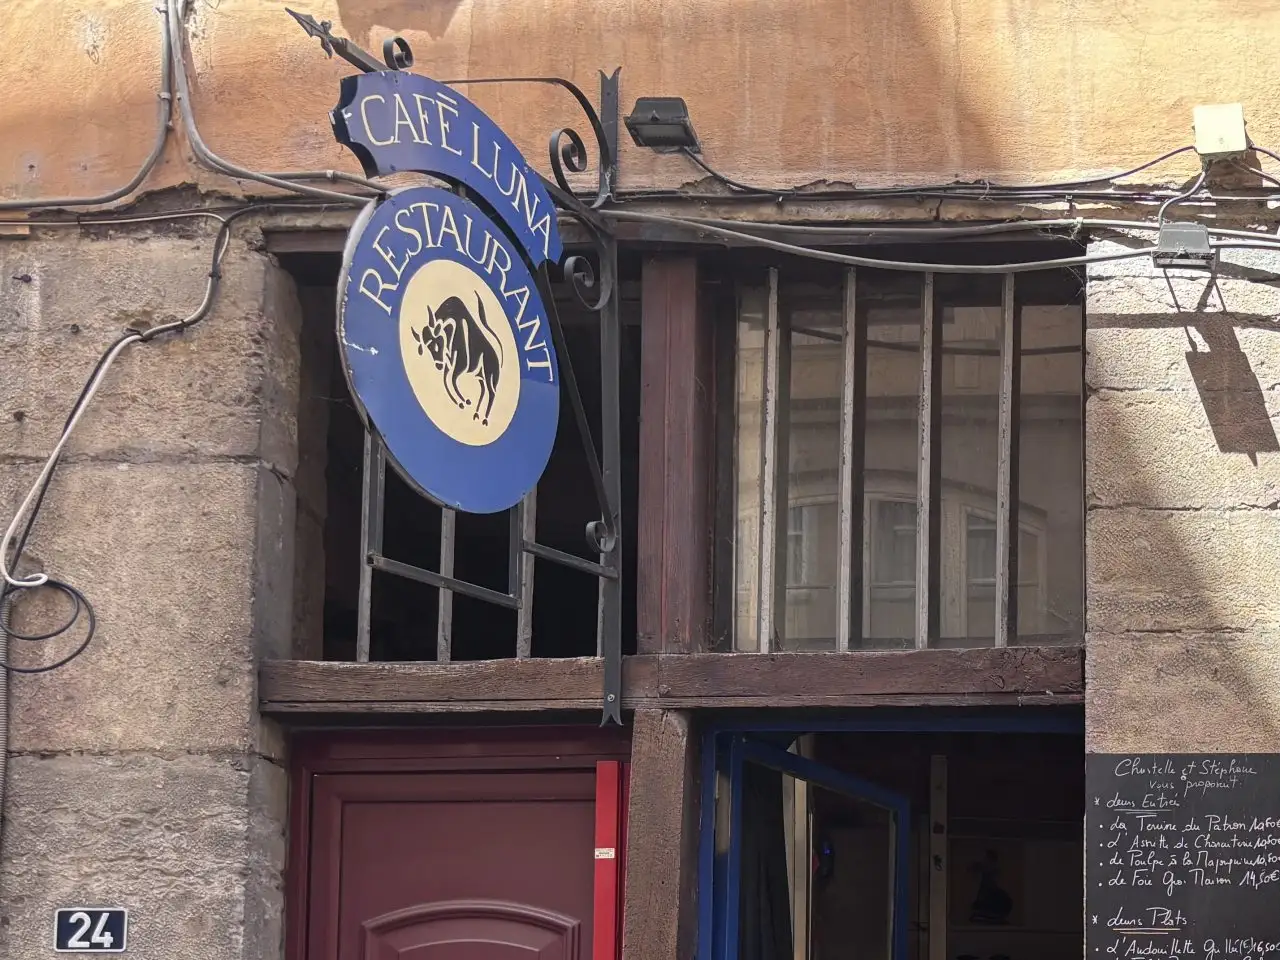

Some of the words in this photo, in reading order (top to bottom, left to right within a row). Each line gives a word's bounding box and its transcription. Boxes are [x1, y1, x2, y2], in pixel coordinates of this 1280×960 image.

[361, 93, 462, 156] CAFÉ
[471, 122, 551, 259] LUNA
[359, 202, 554, 382] RESTAURANT
[1181, 759, 1196, 776] et
[1110, 816, 1126, 830] La
[1182, 818, 1200, 832] du
[1205, 815, 1246, 831] Patron
[1174, 837, 1188, 849] de
[1195, 835, 1252, 848] Charcuterie
[1110, 853, 1124, 865] Le
[1127, 850, 1164, 871] Poulpe
[1108, 871, 1126, 885] Le
[1132, 869, 1152, 886] Foie
[1189, 869, 1231, 886] Maison
[68, 912, 113, 948] 24
